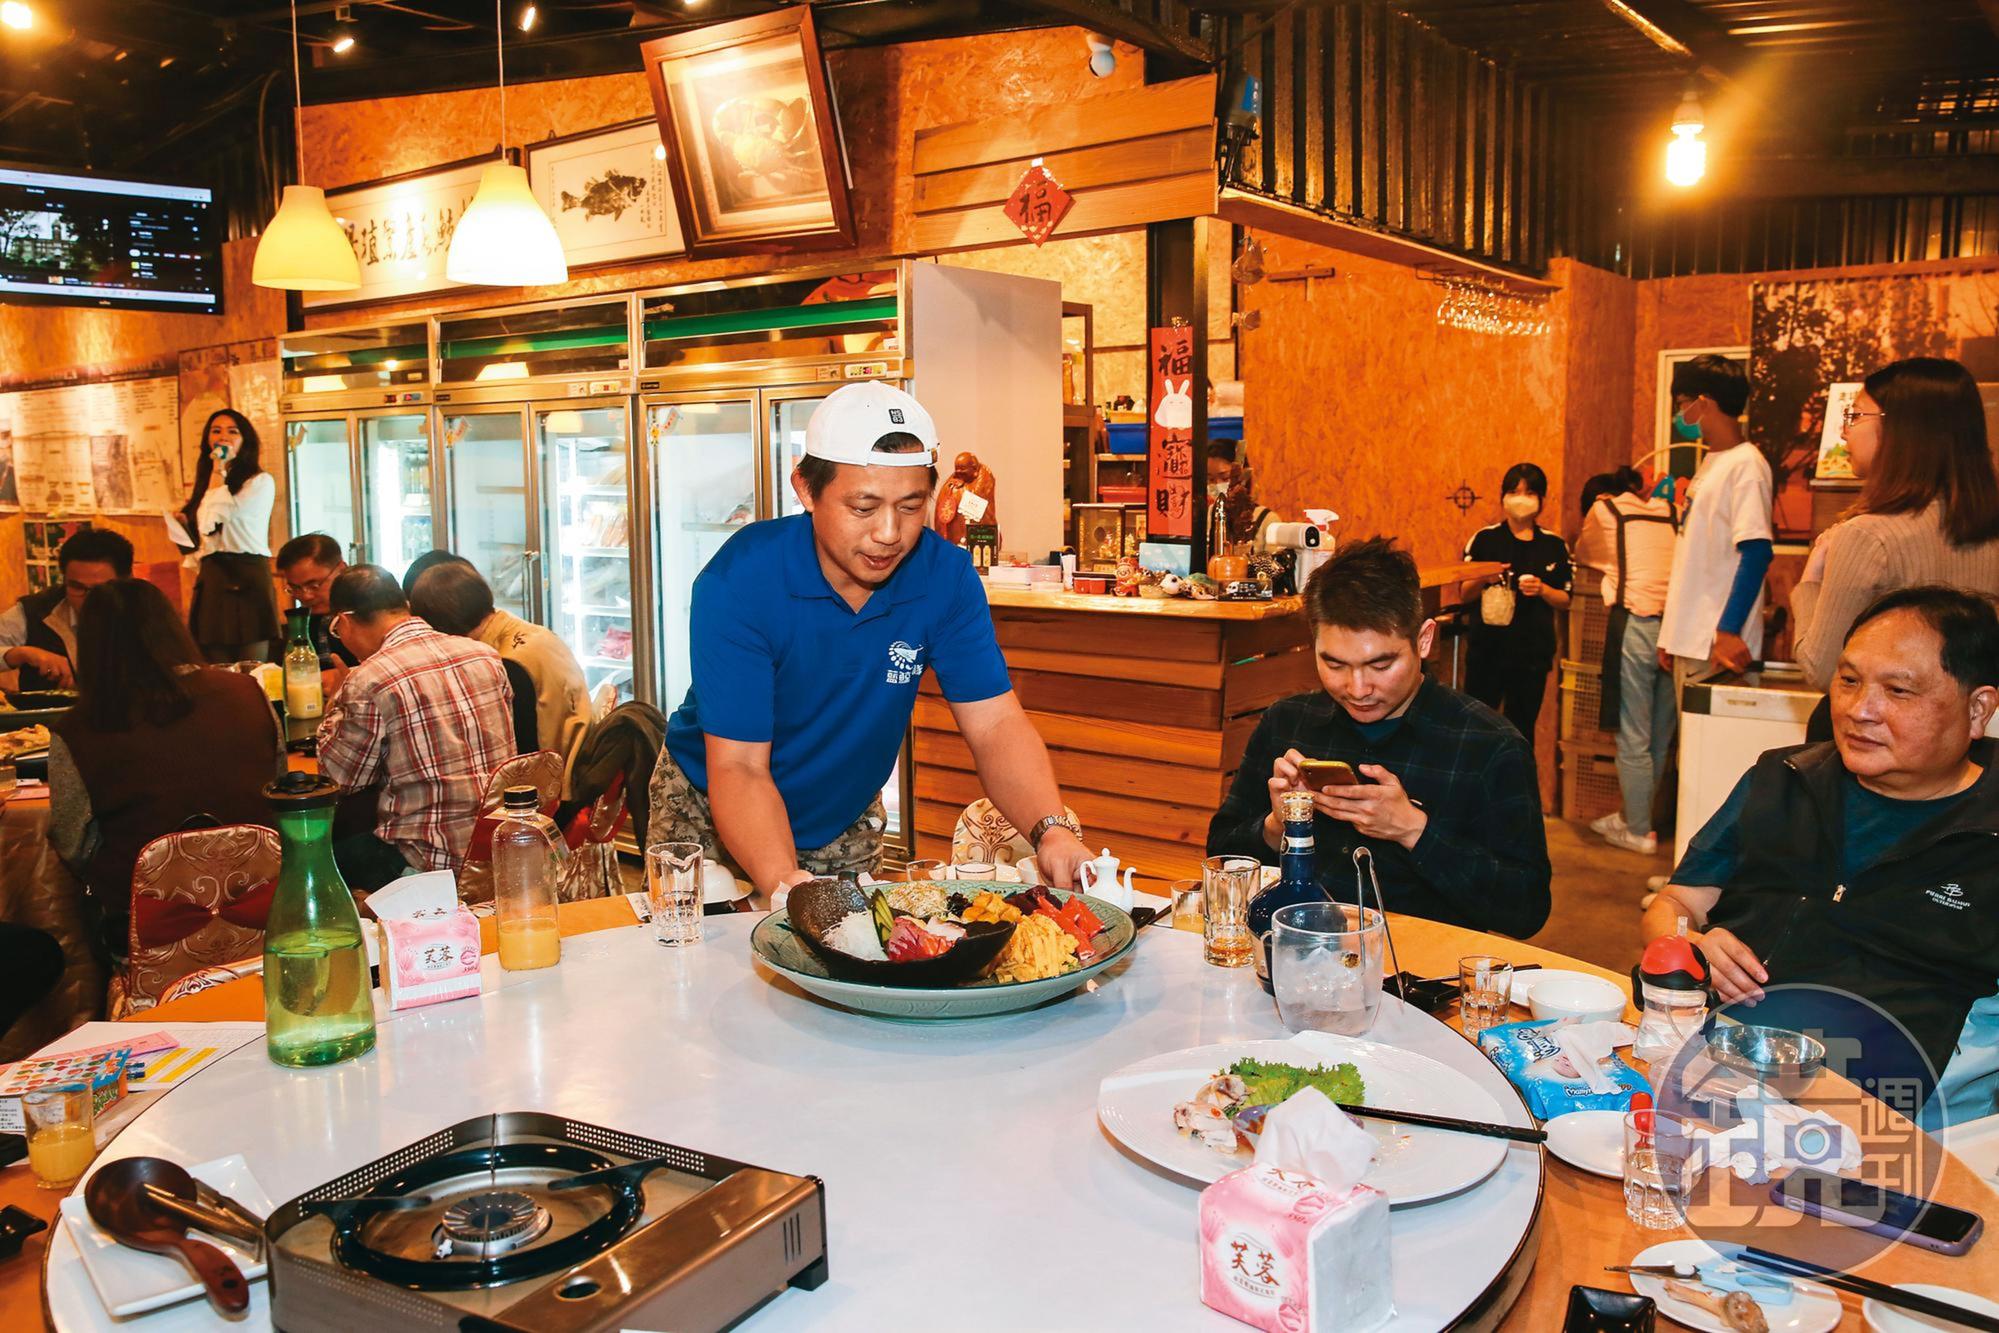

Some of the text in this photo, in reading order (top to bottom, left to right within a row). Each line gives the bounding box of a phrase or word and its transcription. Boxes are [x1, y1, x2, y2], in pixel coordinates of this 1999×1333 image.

[1018, 180, 1053, 224] 福
[424, 945, 454, 964] 芙蓉
[1230, 1241, 1280, 1287] 芙蓉
